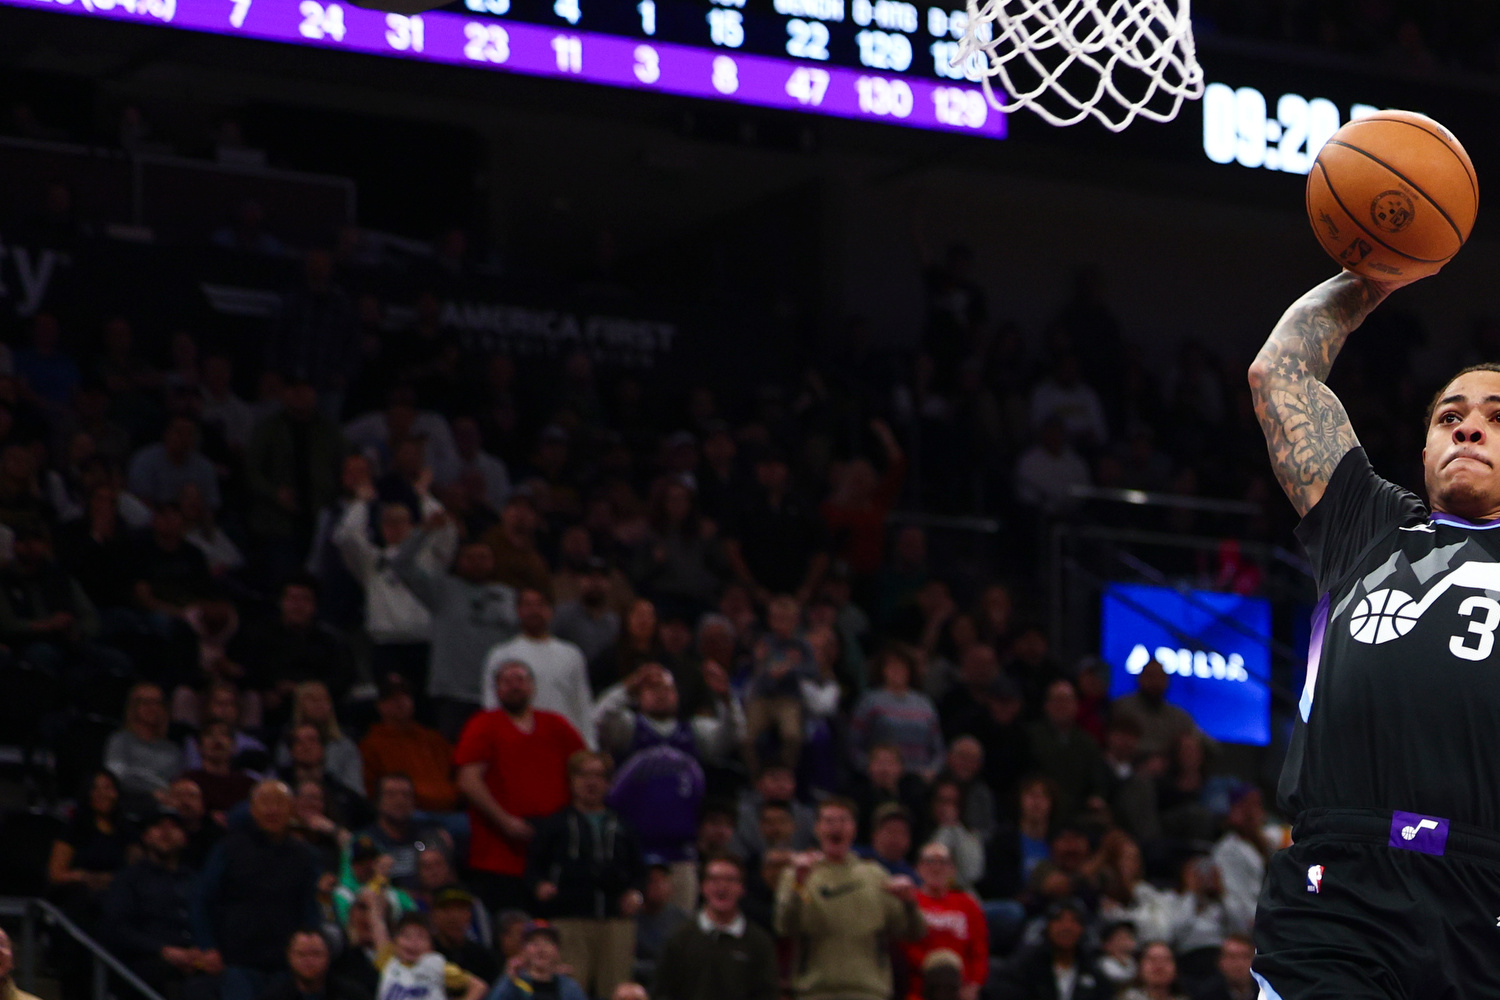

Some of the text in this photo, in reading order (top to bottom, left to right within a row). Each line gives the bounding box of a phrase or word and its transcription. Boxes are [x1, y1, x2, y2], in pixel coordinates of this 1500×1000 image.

[298, 0, 346, 42] 24
[385, 12, 425, 53] 31
[464, 22, 510, 64] 23
[551, 34, 583, 74] 11
[633, 44, 660, 84] 3
[785, 66, 830, 107] 47
[855, 75, 914, 119] 130
[785, 18, 830, 61] 22
